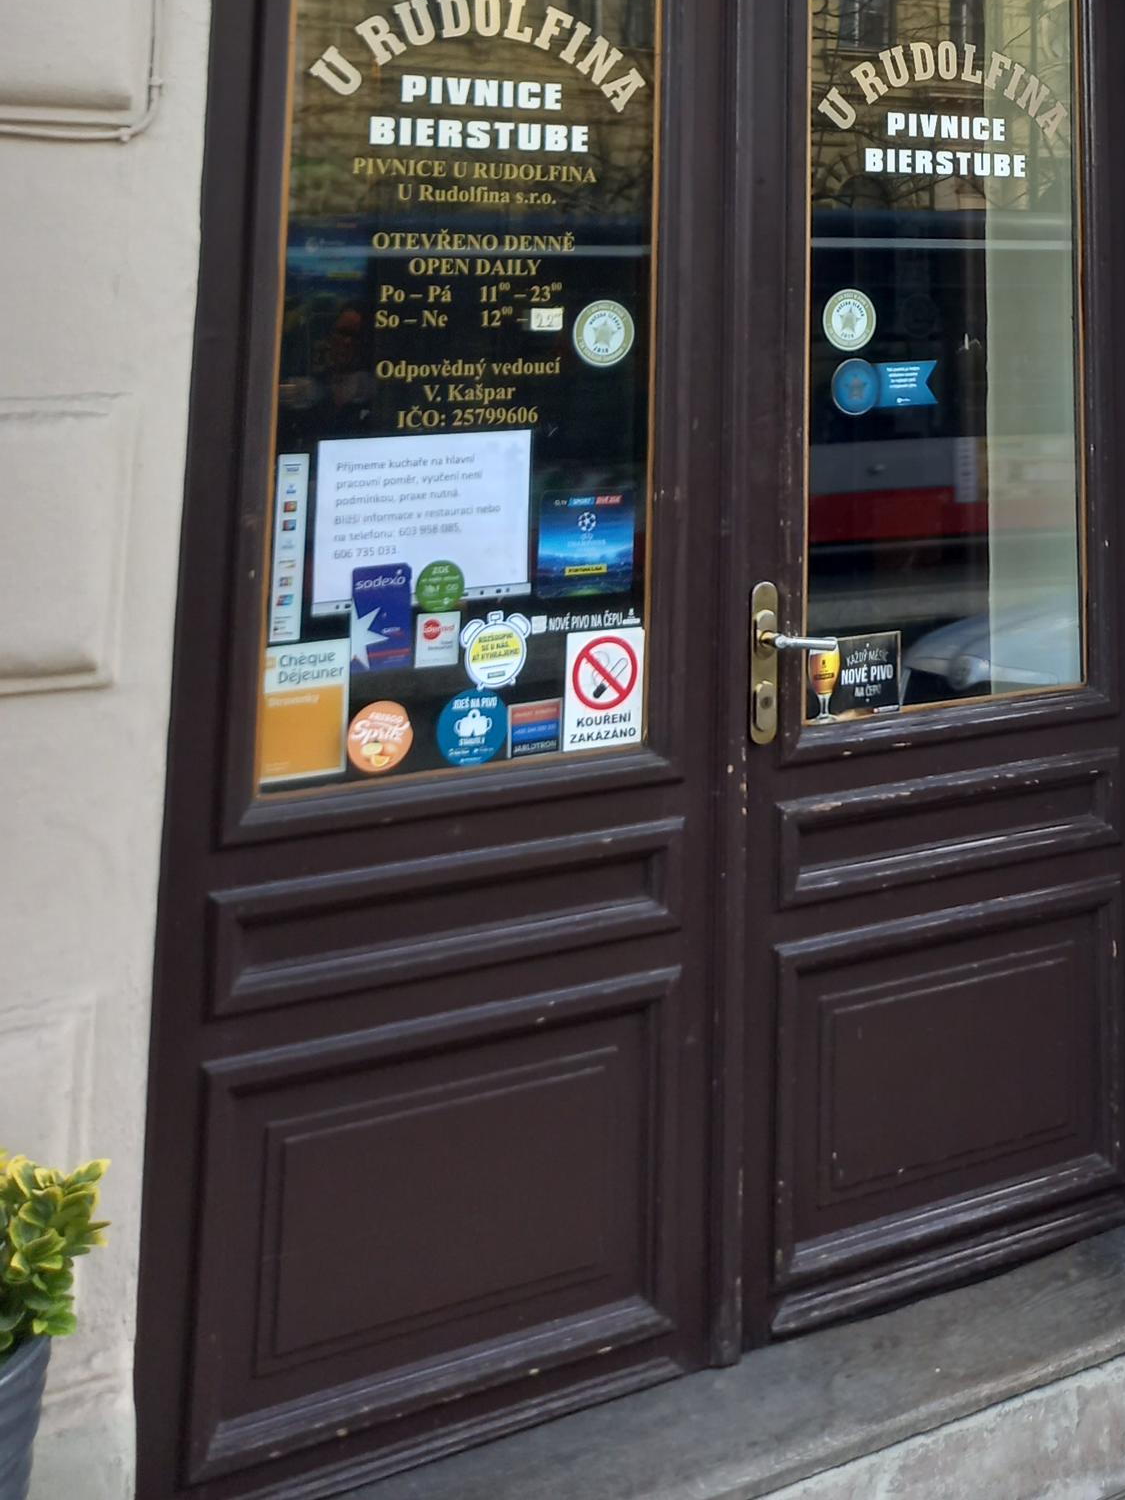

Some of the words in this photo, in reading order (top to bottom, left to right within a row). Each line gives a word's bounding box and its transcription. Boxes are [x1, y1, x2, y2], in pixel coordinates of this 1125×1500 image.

[310, 45, 363, 96] U
[401, 74, 562, 111] PIVNICE
[817, 87, 857, 130] U
[850, 40, 1069, 139] RUDOLFINA
[369, 116, 589, 153] BIERSTUBE
[887, 112, 1005, 142] PIVNICE
[352, 156, 446, 179] PIVNICE
[453, 158, 470, 179] U
[473, 158, 597, 184] RUDOLFINA
[864, 148, 1026, 178] BIERSTUBE
[398, 183, 415, 202] U
[419, 183, 510, 205] Rudolfina
[514, 188, 557, 206] s.r.o.
[372, 228, 498, 253] OTEVŘENO
[503, 231, 576, 253] DENNĚ
[408, 257, 469, 276] OPEN
[474, 257, 542, 277] DAILY
[380, 284, 405, 303] Po
[427, 284, 452, 303] Pá
[375, 310, 400, 329] So
[421, 310, 449, 329] Ne
[376, 357, 486, 380] Odpovědný
[490, 357, 561, 376] vedoucí
[423, 385, 443, 404] V.
[447, 383, 516, 405] Kašpar
[397, 408, 446, 429] IČO:
[452, 406, 539, 427] 25799606
[431, 458, 443, 466] na
[336, 478, 380, 490] pracovní
[399, 492, 426, 503] praxe
[362, 511, 413, 524] informace
[424, 506, 474, 519] restauraci
[476, 504, 501, 515] nebo
[333, 534, 346, 542] na
[355, 546, 376, 558] 735
[354, 569, 406, 590] sodexo
[549, 611, 571, 631] NOVÉ
[571, 614, 590, 629] PIVO
[591, 614, 602, 628] NA
[603, 607, 623, 627] ČEPU
[278, 666, 344, 684] Déjeuner
[840, 664, 868, 685] NOVÉ
[870, 664, 894, 681] PIVO
[854, 686, 865, 697] NA
[576, 710, 632, 728] KOUŘENÍ
